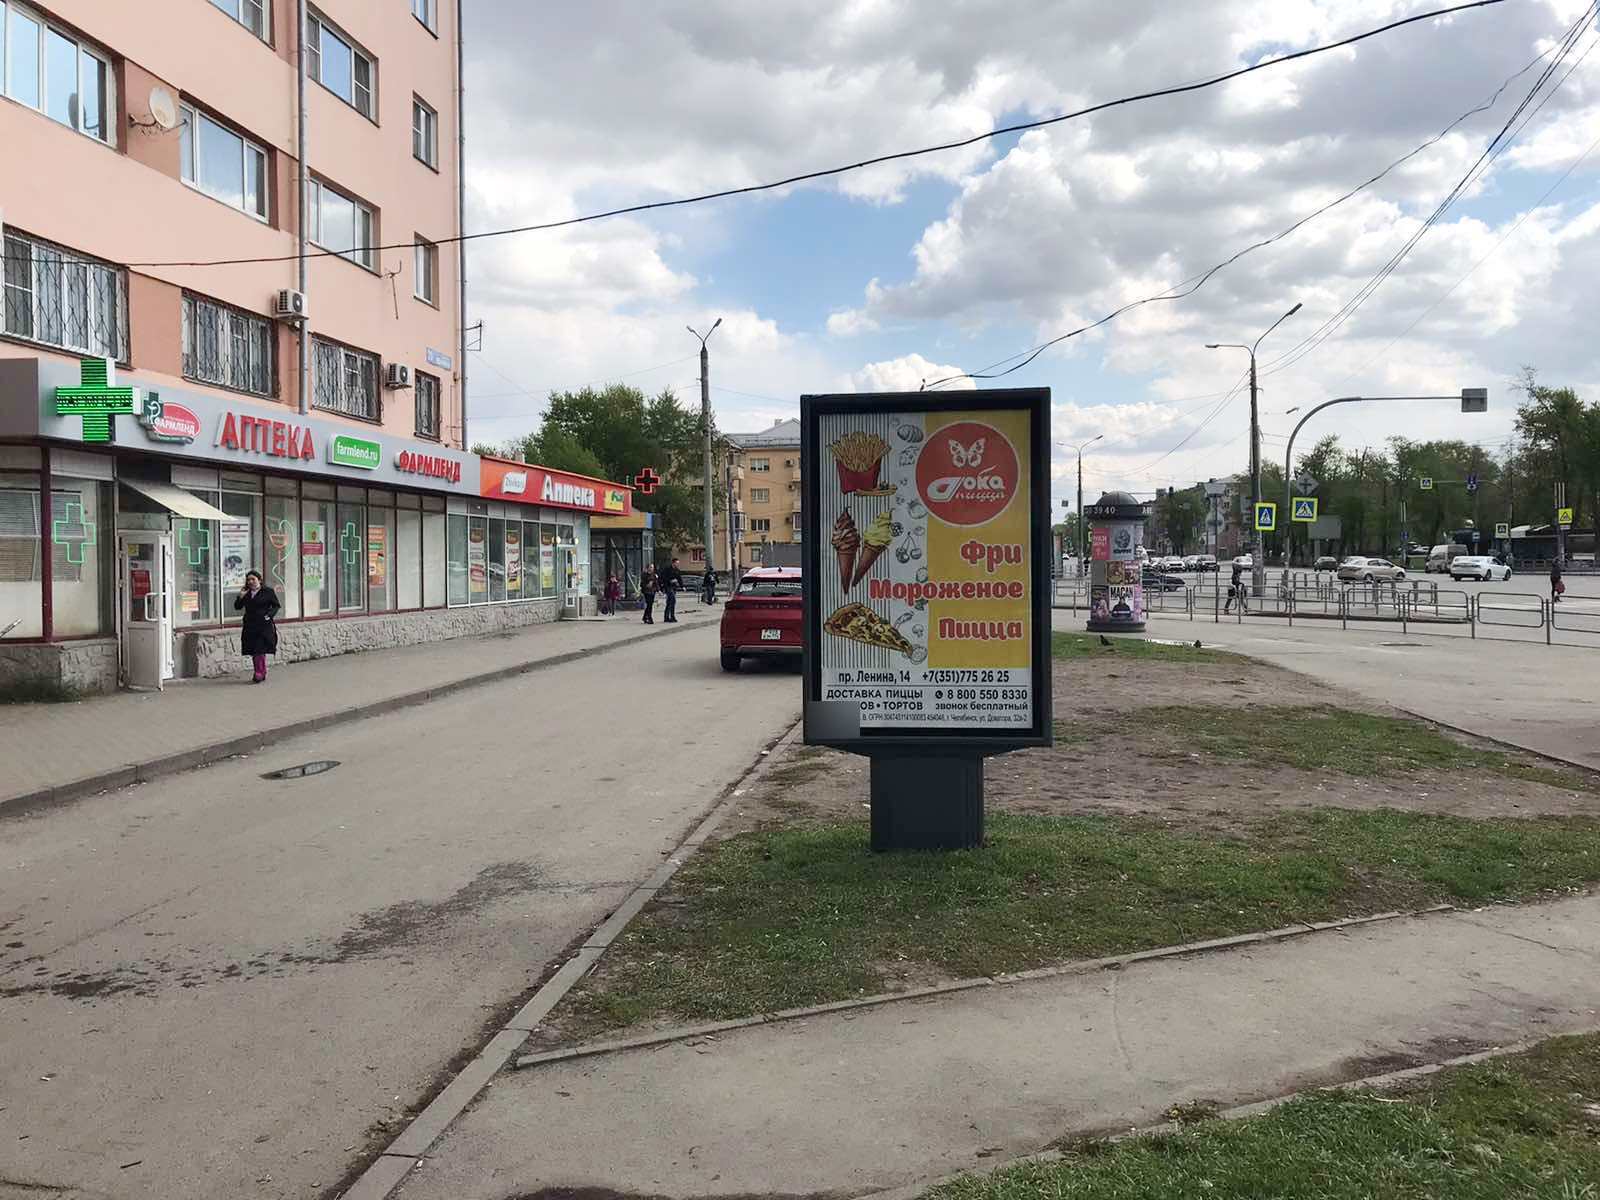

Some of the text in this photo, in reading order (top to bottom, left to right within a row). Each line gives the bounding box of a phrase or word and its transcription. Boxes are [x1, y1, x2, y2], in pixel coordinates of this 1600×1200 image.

[216, 410, 315, 461] АПТЕКА
[336, 441, 378, 460] farmlend.ru
[398, 450, 461, 484] ФАРМЛЕНД
[543, 474, 595, 508] Аптека
[961, 540, 1023, 572] Фри
[869, 579, 1024, 607] Мороженое
[939, 617, 1023, 640] Пицца
[838, 670, 911, 684] пр. Ленина, 14
[922, 670, 1010, 684] +7(351)775 26 25
[826, 689, 923, 700] ДОСТАВКА ПИЦЦЫ
[947, 689, 1028, 699] 8 800 550 8330
[883, 701, 923, 710] ТОРТОВ
[935, 701, 1028, 710] звонок бесплатный
